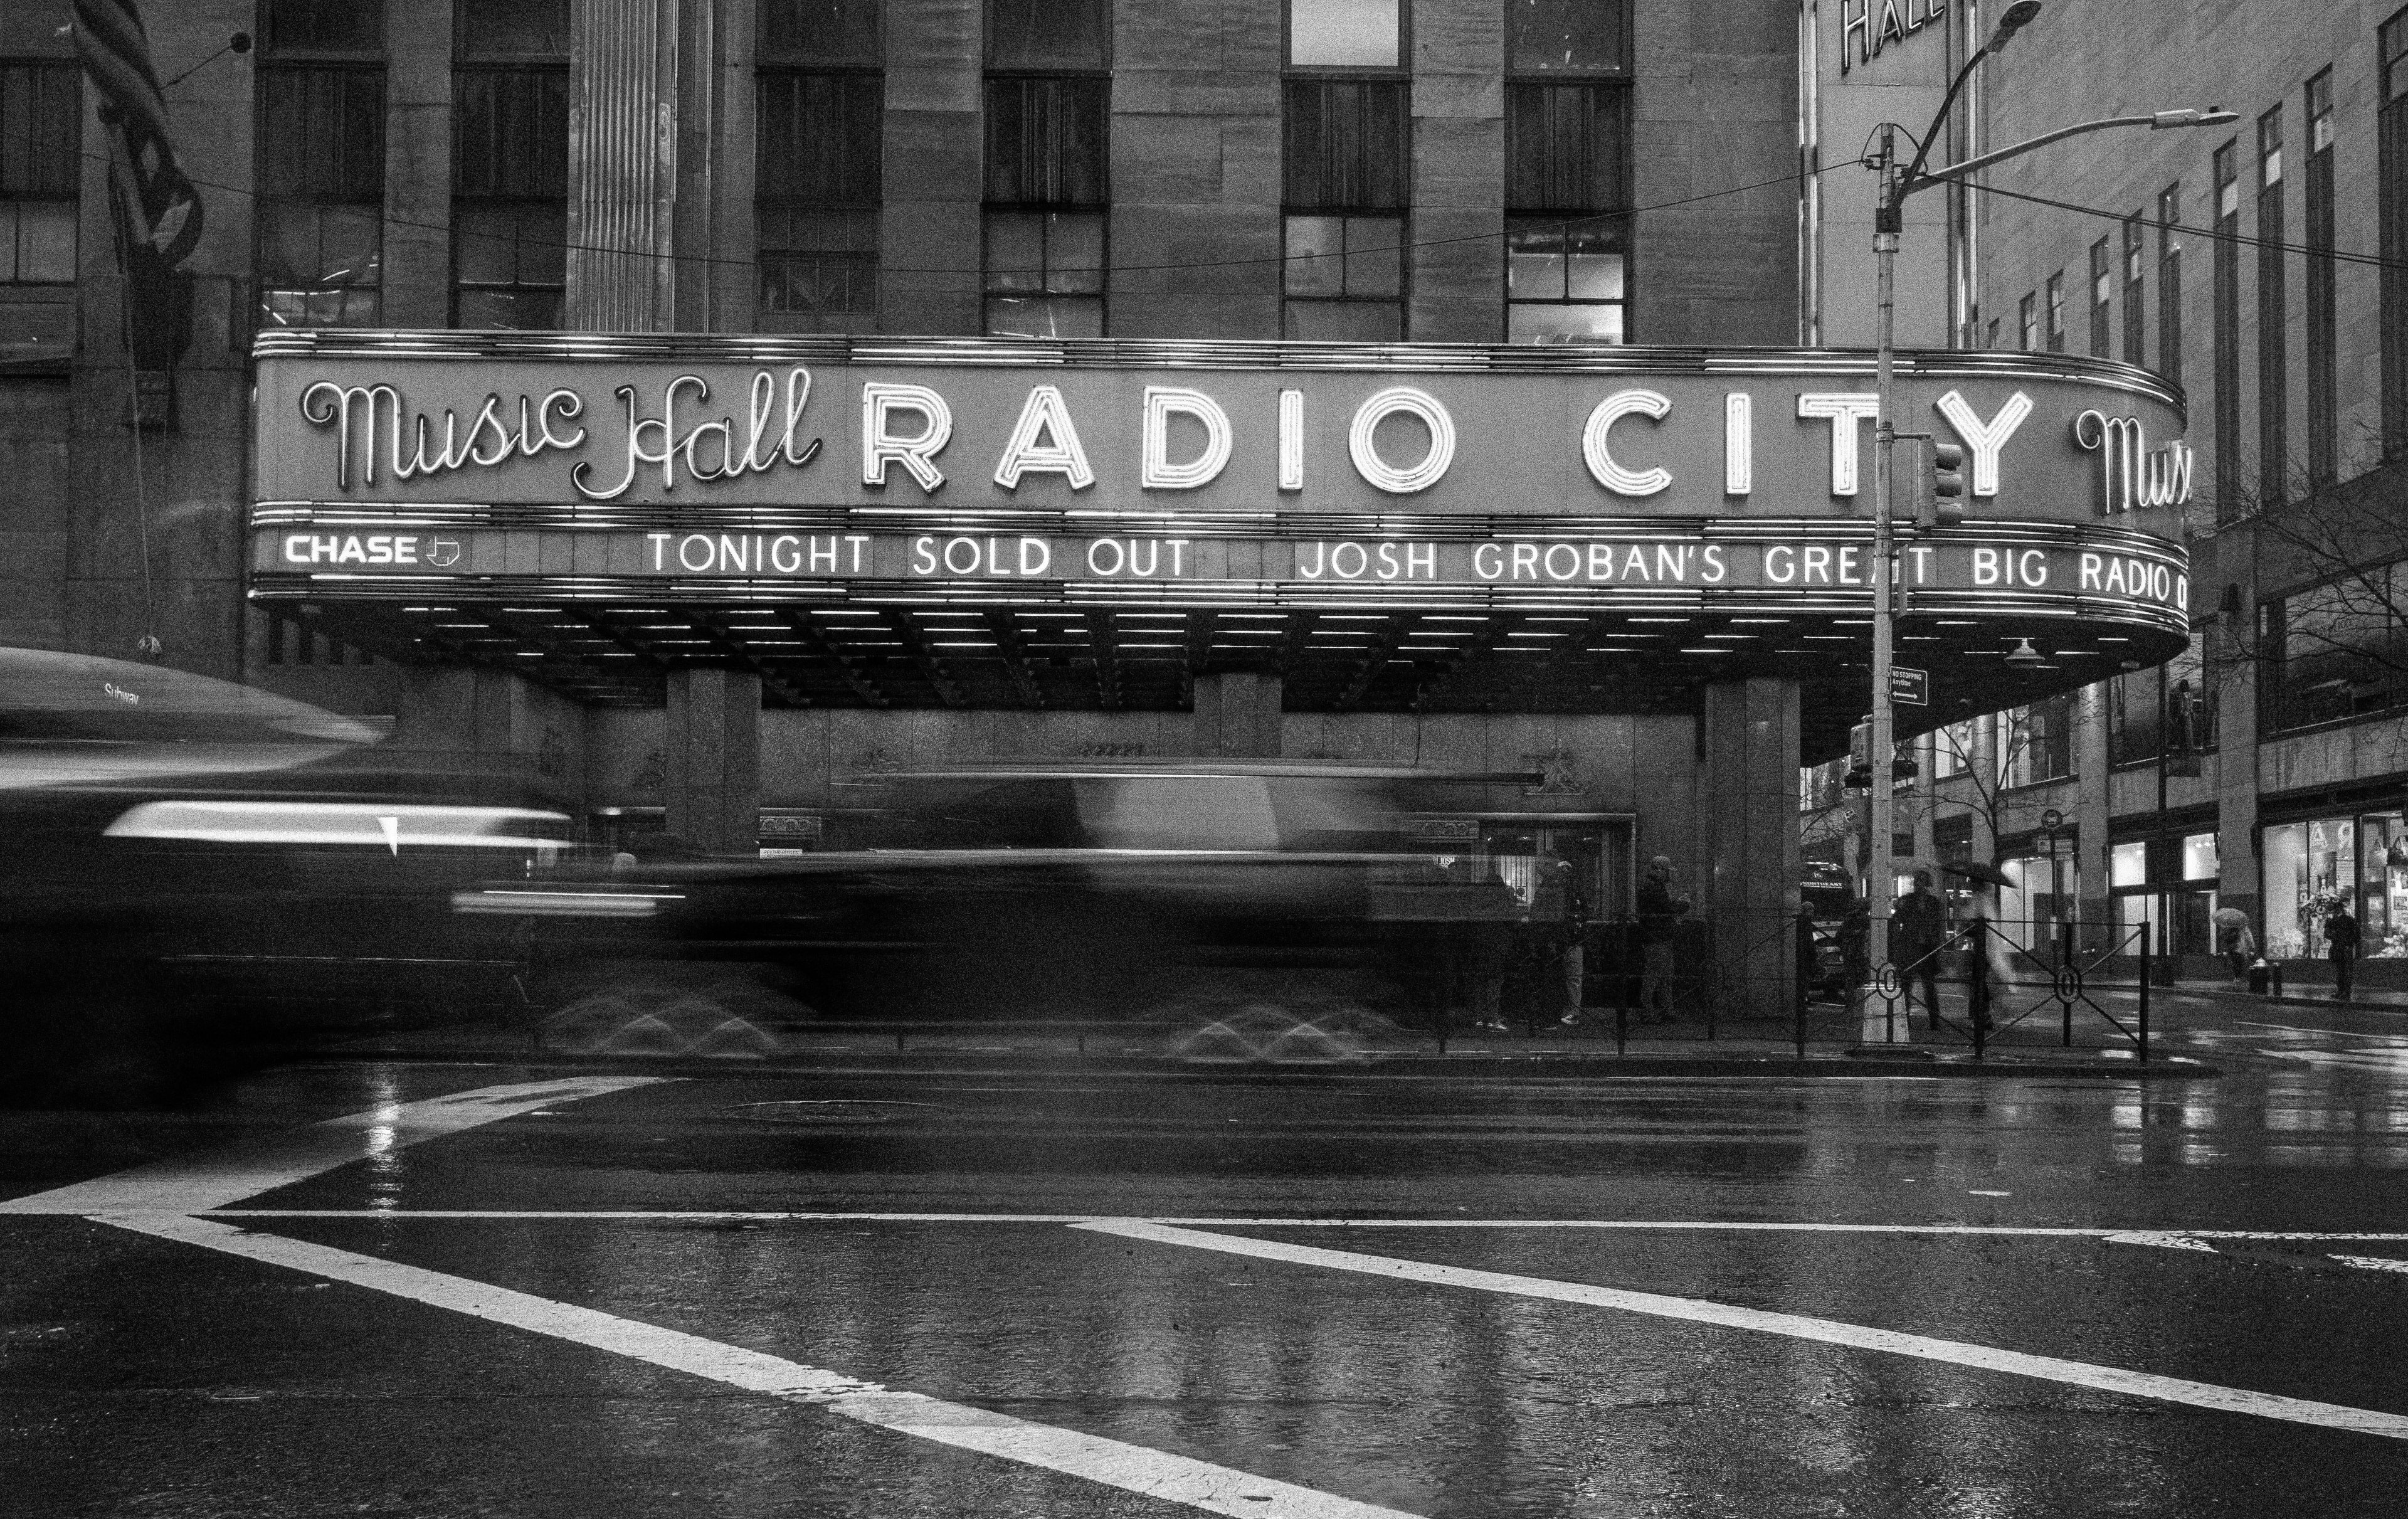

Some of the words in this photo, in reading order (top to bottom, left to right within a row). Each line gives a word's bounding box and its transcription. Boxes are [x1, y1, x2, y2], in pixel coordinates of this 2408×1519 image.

[299, 379, 587, 489] Music
[570, 366, 823, 499] Hall
[861, 381, 1456, 494] RADIO
[1582, 388, 2034, 497] CITY
[285, 534, 419, 564] CHASE
[647, 533, 869, 573] TONIGHT
[913, 536, 1051, 575] SOLD
[1087, 537, 1190, 576] OUT
[1301, 540, 1436, 580] JOSH
[1474, 542, 1725, 583] GROBAN'S
[1764, 544, 1933, 585] GRET
[1973, 548, 2047, 587] BIG
[2080, 553, 2170, 602] RADIO
[1892, 678, 1911, 687] Anytime
[1899, 671, 1922, 680] STOPPING
